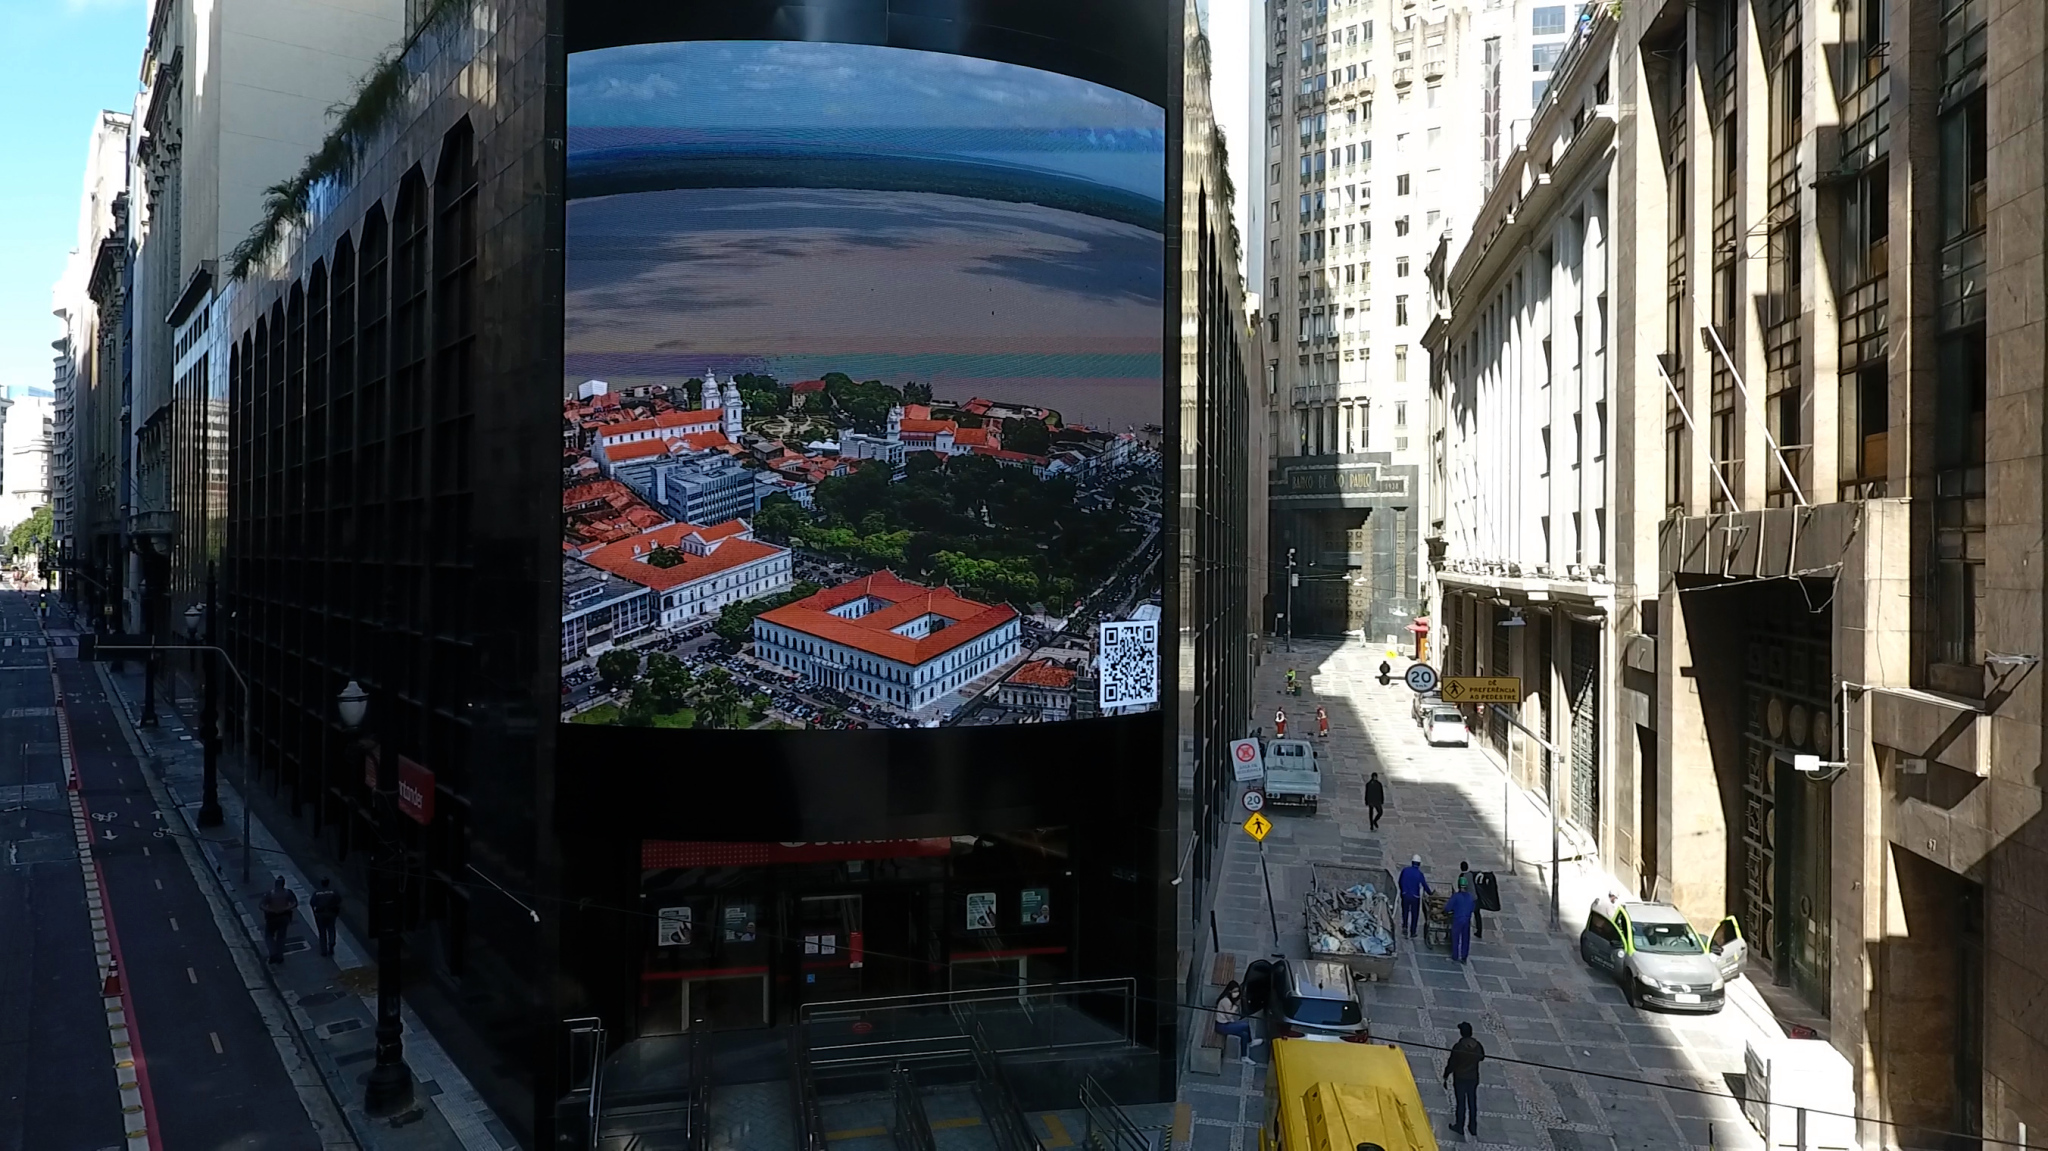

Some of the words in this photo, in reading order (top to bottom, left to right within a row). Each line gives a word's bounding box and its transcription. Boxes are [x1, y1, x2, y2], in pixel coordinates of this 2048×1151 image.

[1319, 474, 1328, 489] DE
[1349, 472, 1372, 488] PAULO
[1411, 671, 1431, 683] 20
[1246, 795, 1261, 805] 20
